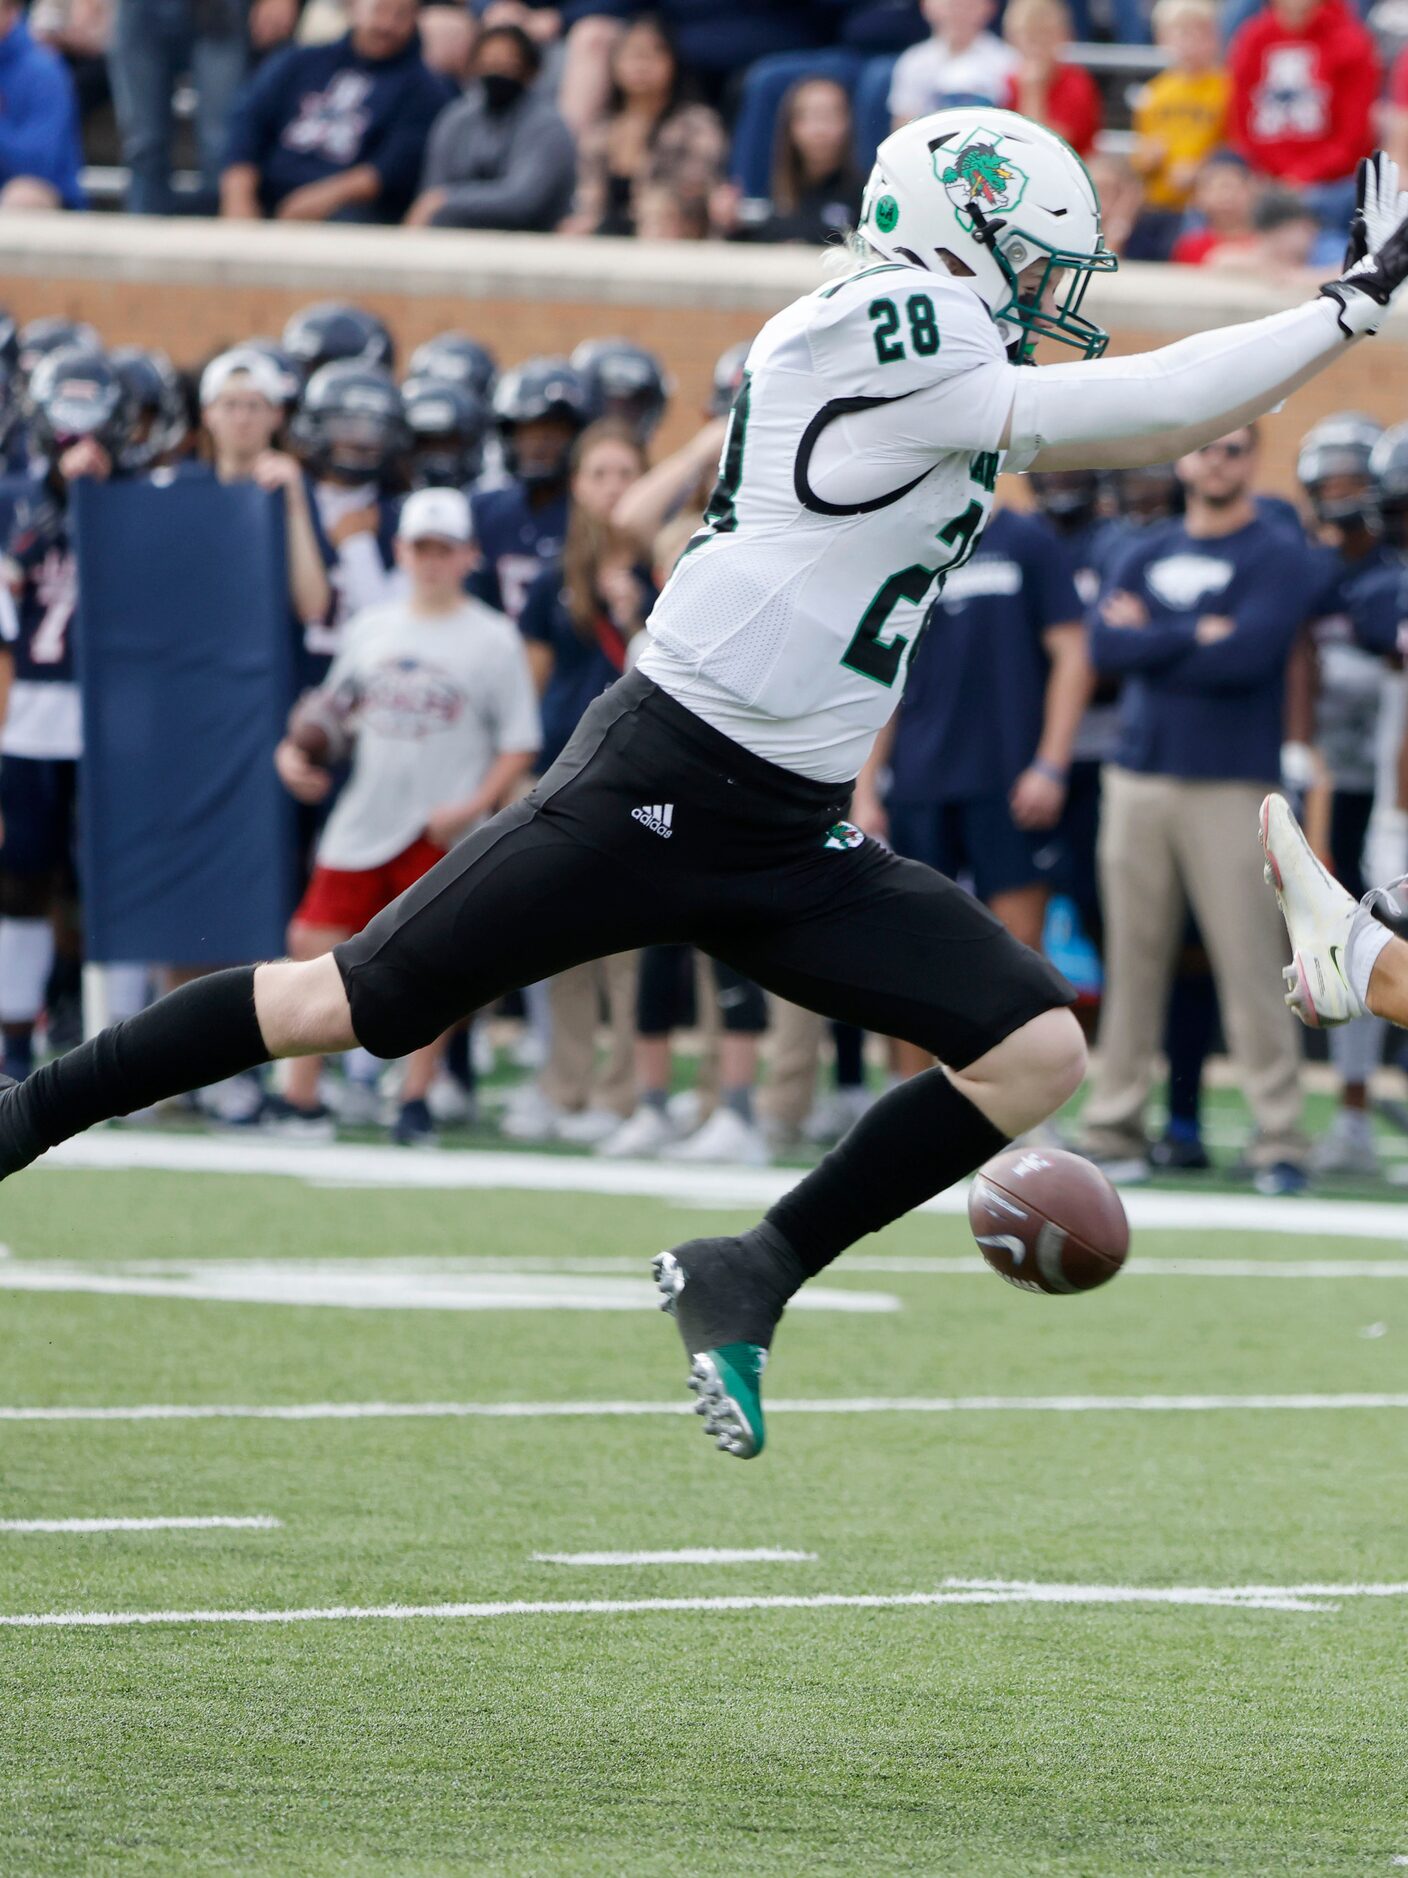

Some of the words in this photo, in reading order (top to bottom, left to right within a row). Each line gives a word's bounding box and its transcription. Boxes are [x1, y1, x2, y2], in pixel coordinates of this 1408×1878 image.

[868, 293, 940, 365] 28
[839, 499, 984, 688] 2
[631, 808, 673, 839] adidas
